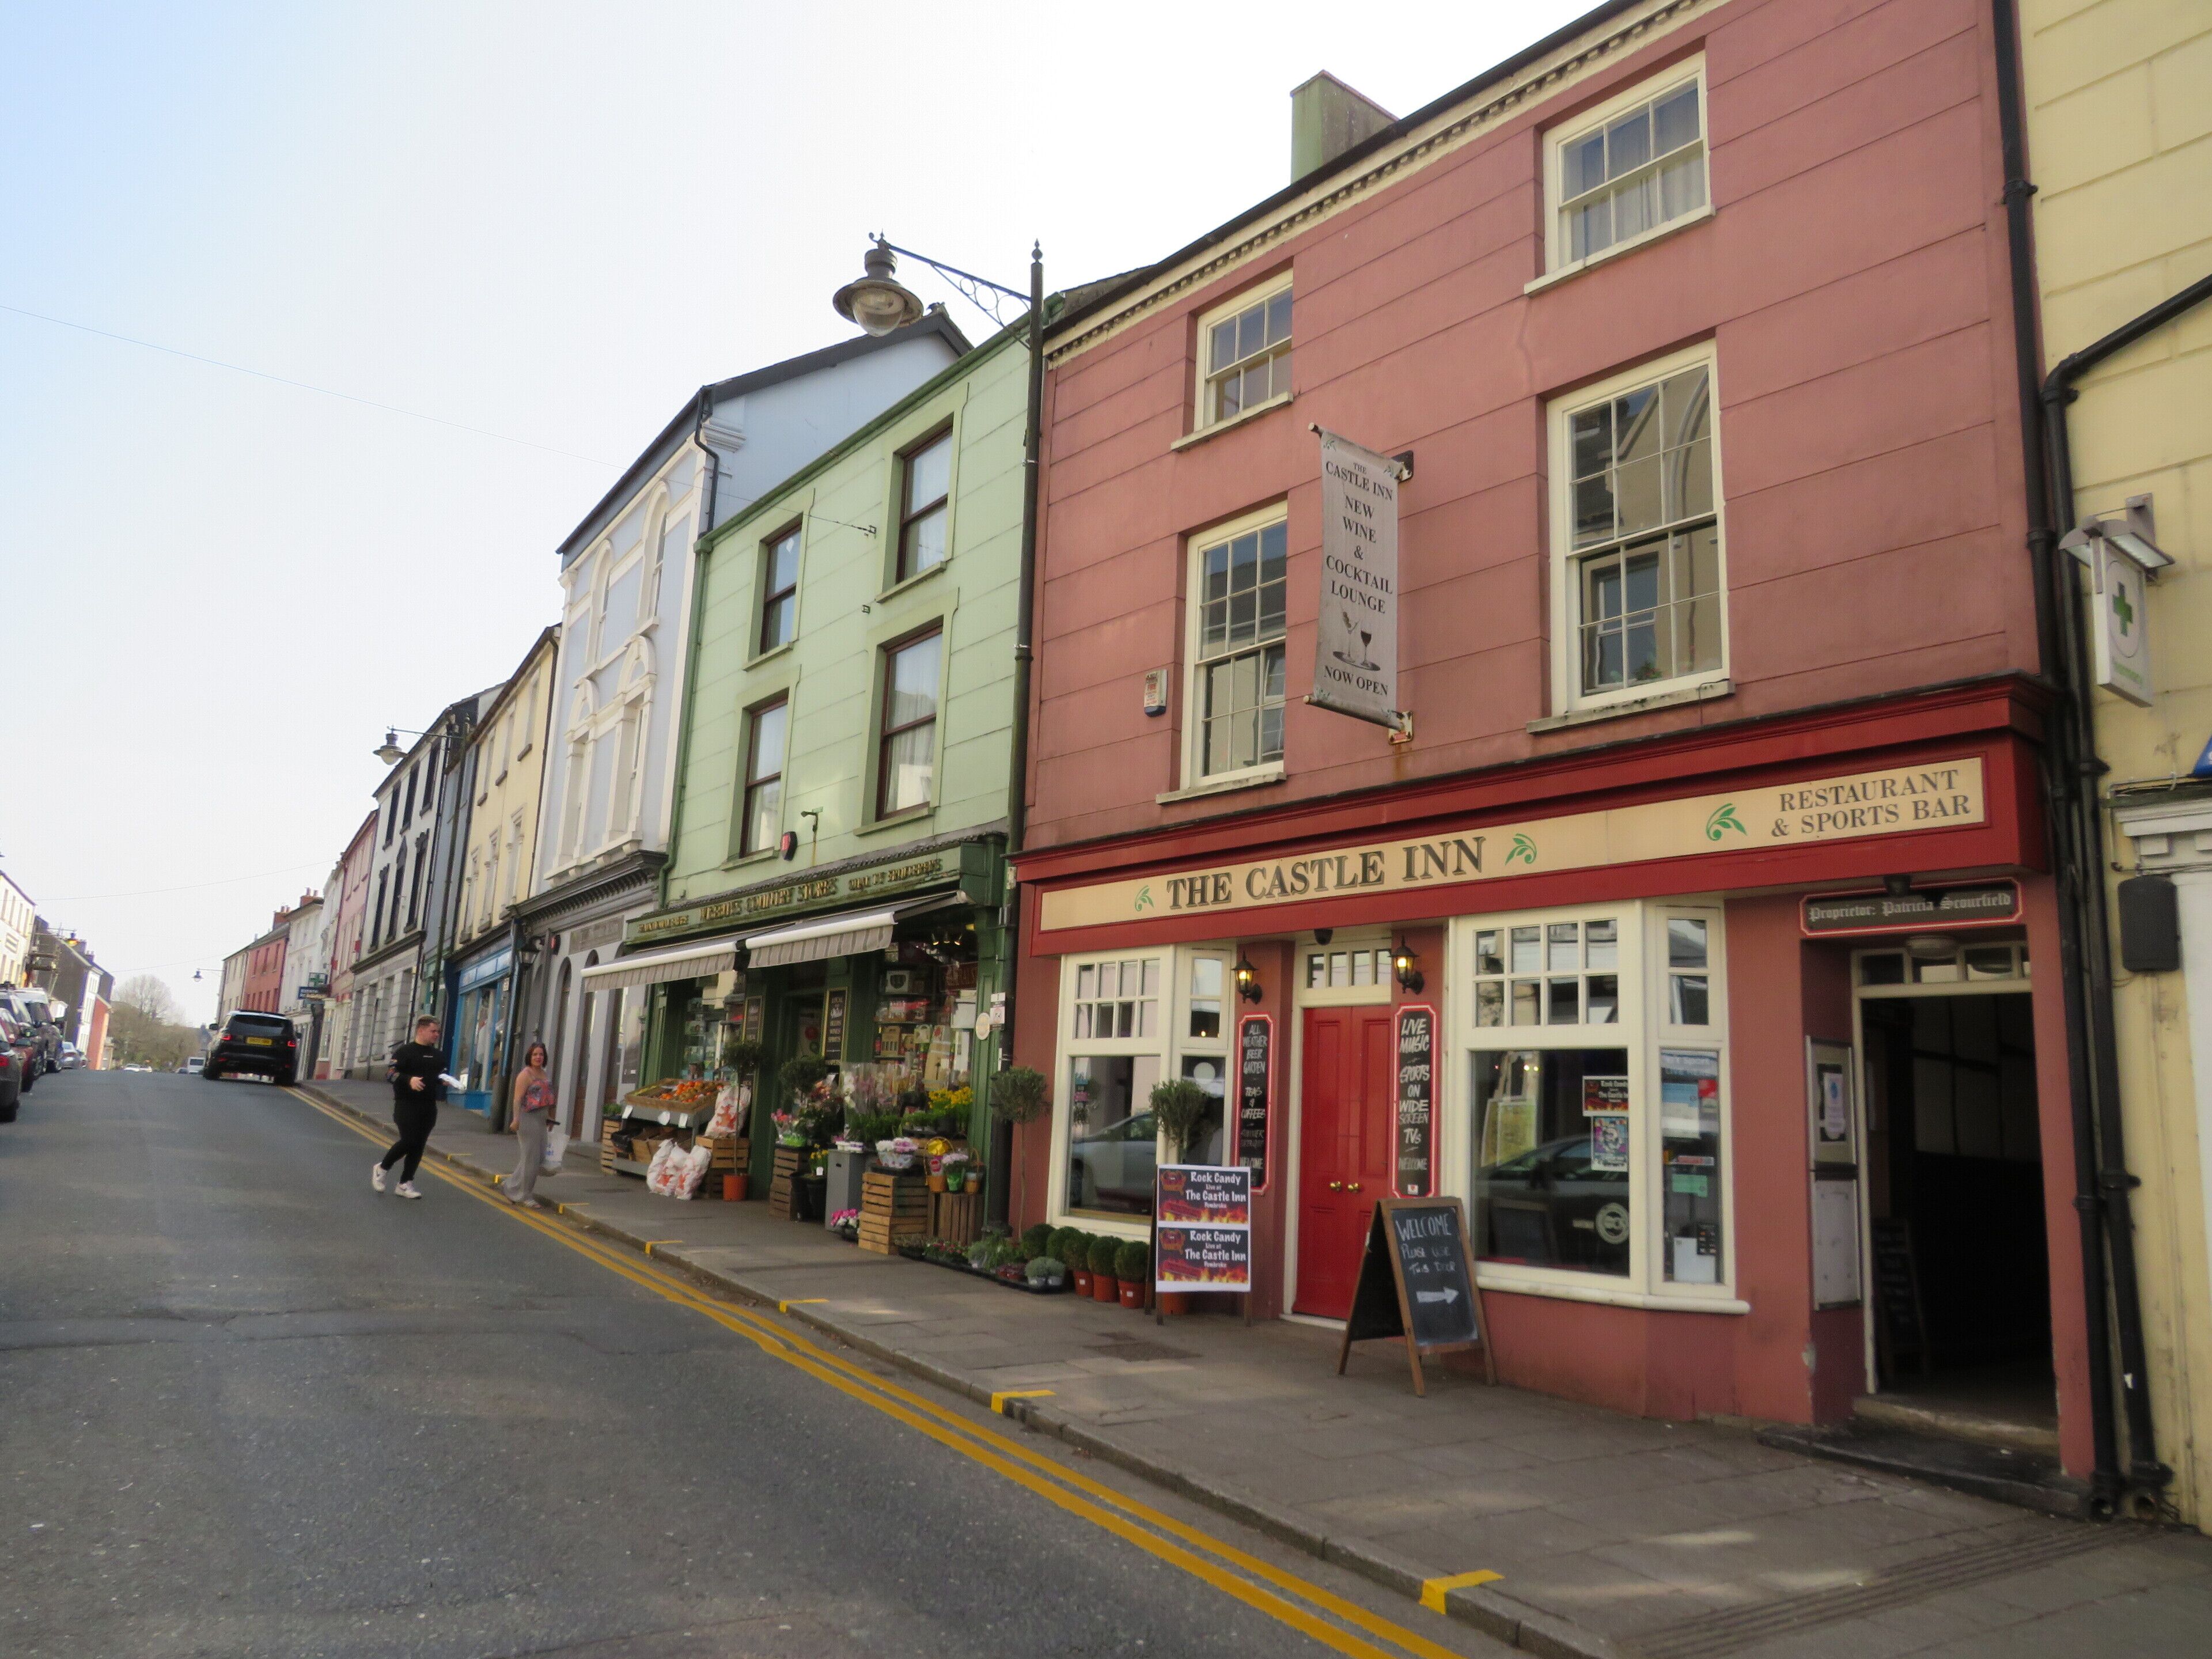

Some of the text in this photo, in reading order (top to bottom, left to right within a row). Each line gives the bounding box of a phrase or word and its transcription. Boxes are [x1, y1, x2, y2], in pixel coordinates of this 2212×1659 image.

[1353, 462, 1367, 474] THE
[1325, 460, 1393, 502] CASTLE INN
[1344, 495, 1374, 520] NEW
[1343, 516, 1376, 543] WINE
[1354, 545, 1364, 560] &
[1326, 555, 1392, 595] COCKTAIL
[1331, 579, 1386, 614] LOUNGE
[1324, 665, 1388, 696] NOW OPEN
[1779, 769, 1959, 812] RESTAURANT
[1771, 794, 1971, 837] & SPORTS BAR
[1166, 835, 1487, 911] THE CASTLE INN
[1402, 1018, 1427, 1036] LIVE
[1247, 1048, 1263, 1059] BEER
[1400, 1035, 1430, 1054] MUSIC
[1243, 1061, 1266, 1074] GARDEN
[1399, 1065, 1430, 1084] SPORTS
[1408, 1084, 1421, 1097] ON
[1399, 1100, 1430, 1113] WIDE
[1399, 1112, 1429, 1125] SCREEN
[1191, 1171, 1213, 1183] Rock
[1214, 1172, 1241, 1185] Candy
[1185, 1190, 1247, 1202] The Castle Inn
[1395, 1213, 1452, 1241] WELCOME
[1190, 1230, 1241, 1244] Rock Candy
[1185, 1248, 1246, 1261] The Castle Inn
